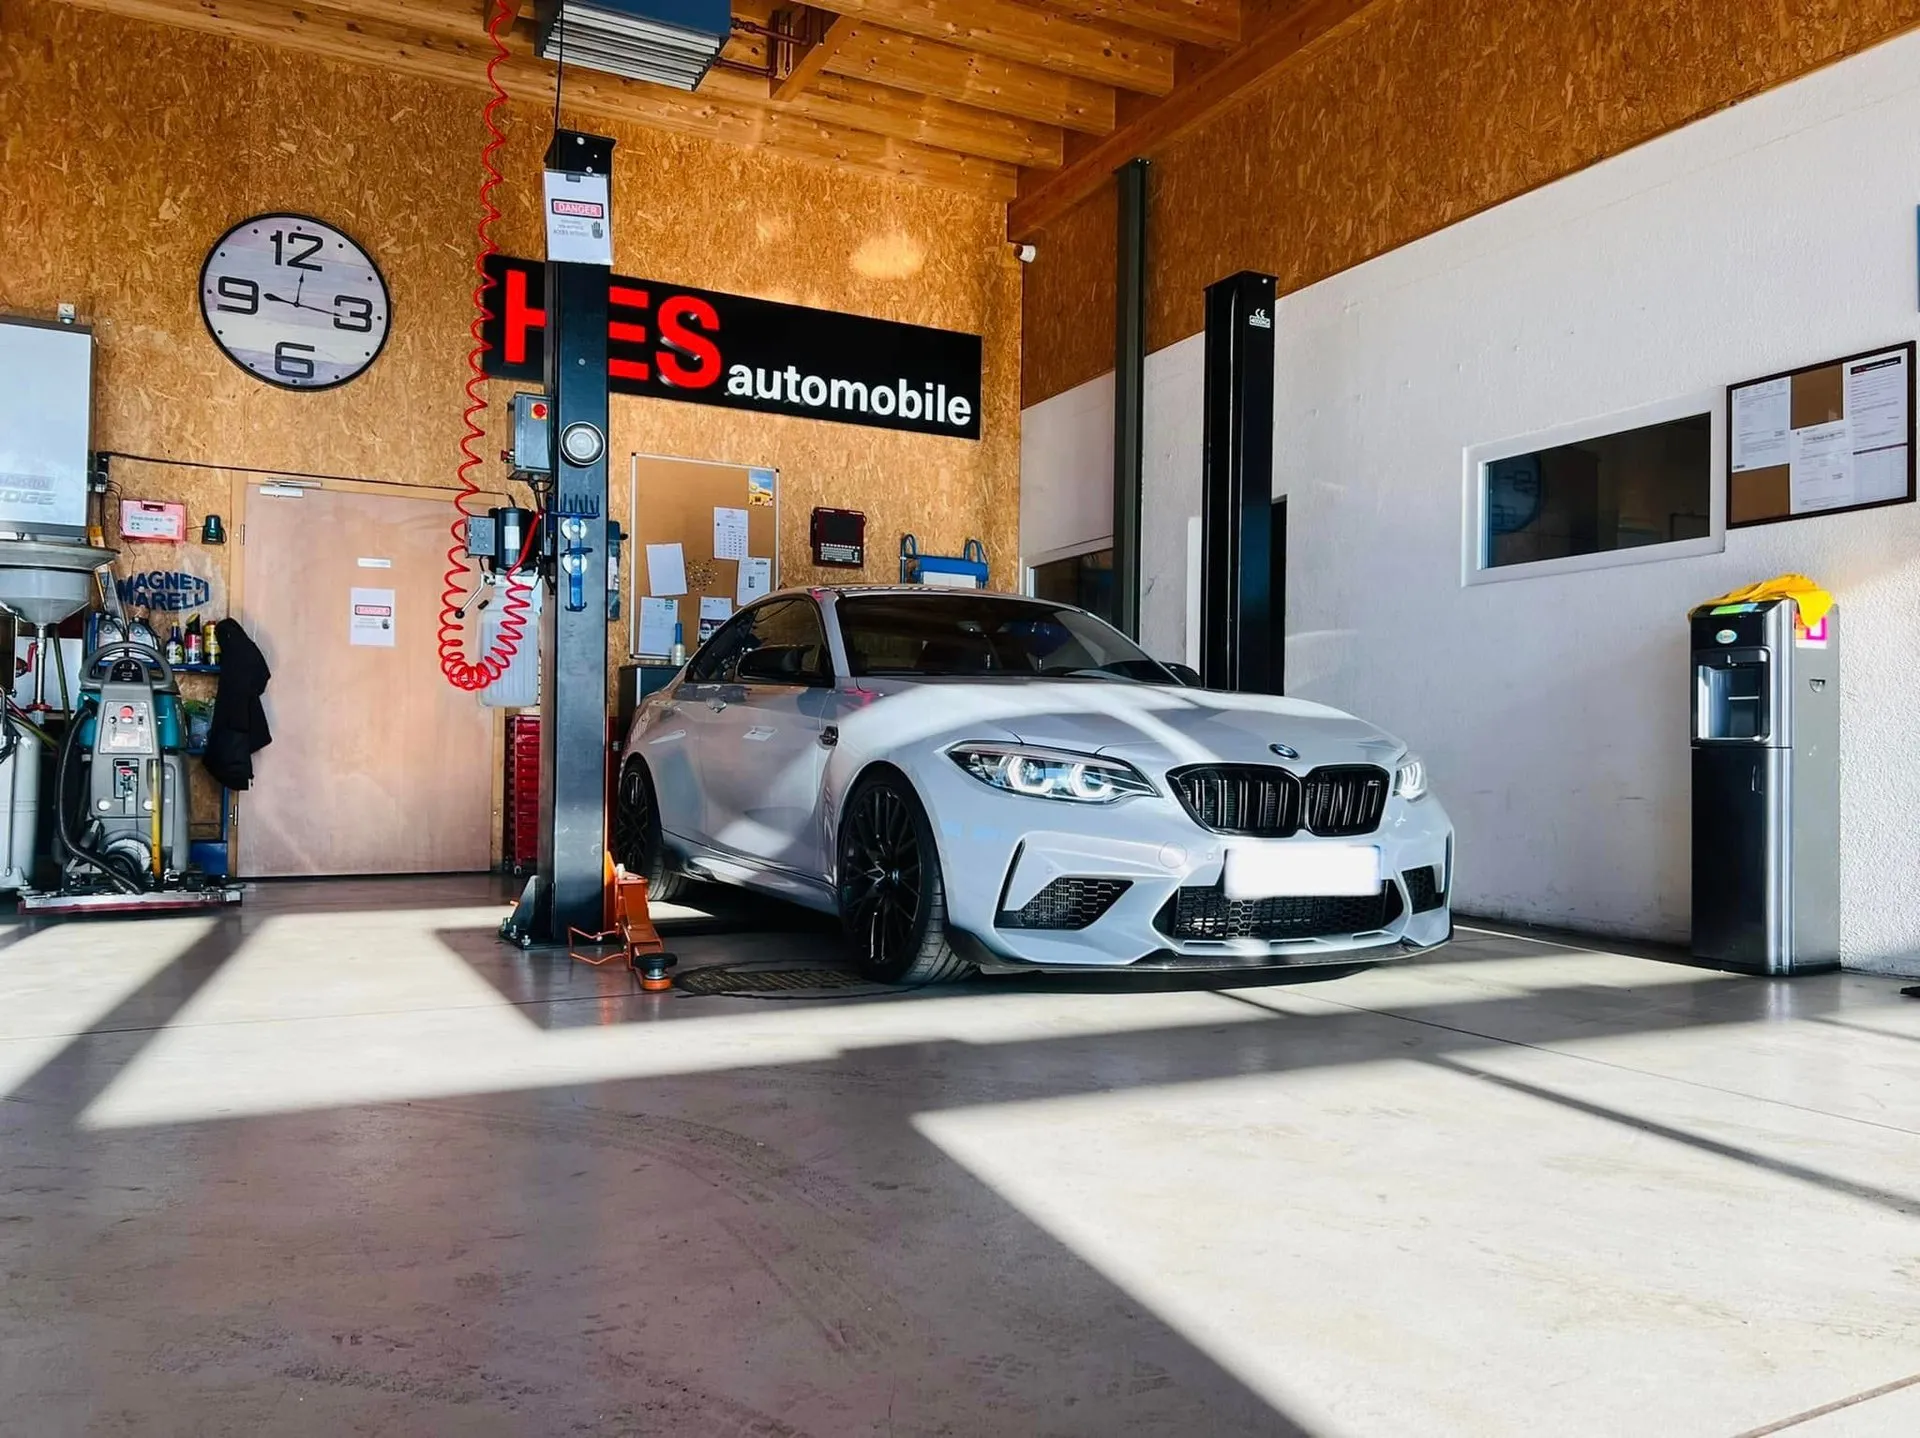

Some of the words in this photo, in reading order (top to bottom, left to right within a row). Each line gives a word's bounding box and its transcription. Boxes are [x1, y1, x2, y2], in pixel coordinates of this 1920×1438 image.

[558, 203, 598, 216] DANGER
[269, 230, 323, 272] 12
[217, 276, 259, 315] 9
[333, 294, 373, 333] 3
[274, 341, 316, 379] 6
[727, 363, 972, 426] automobile
[0, 490, 57, 506] DGE
[117, 570, 209, 594] MAGNETI
